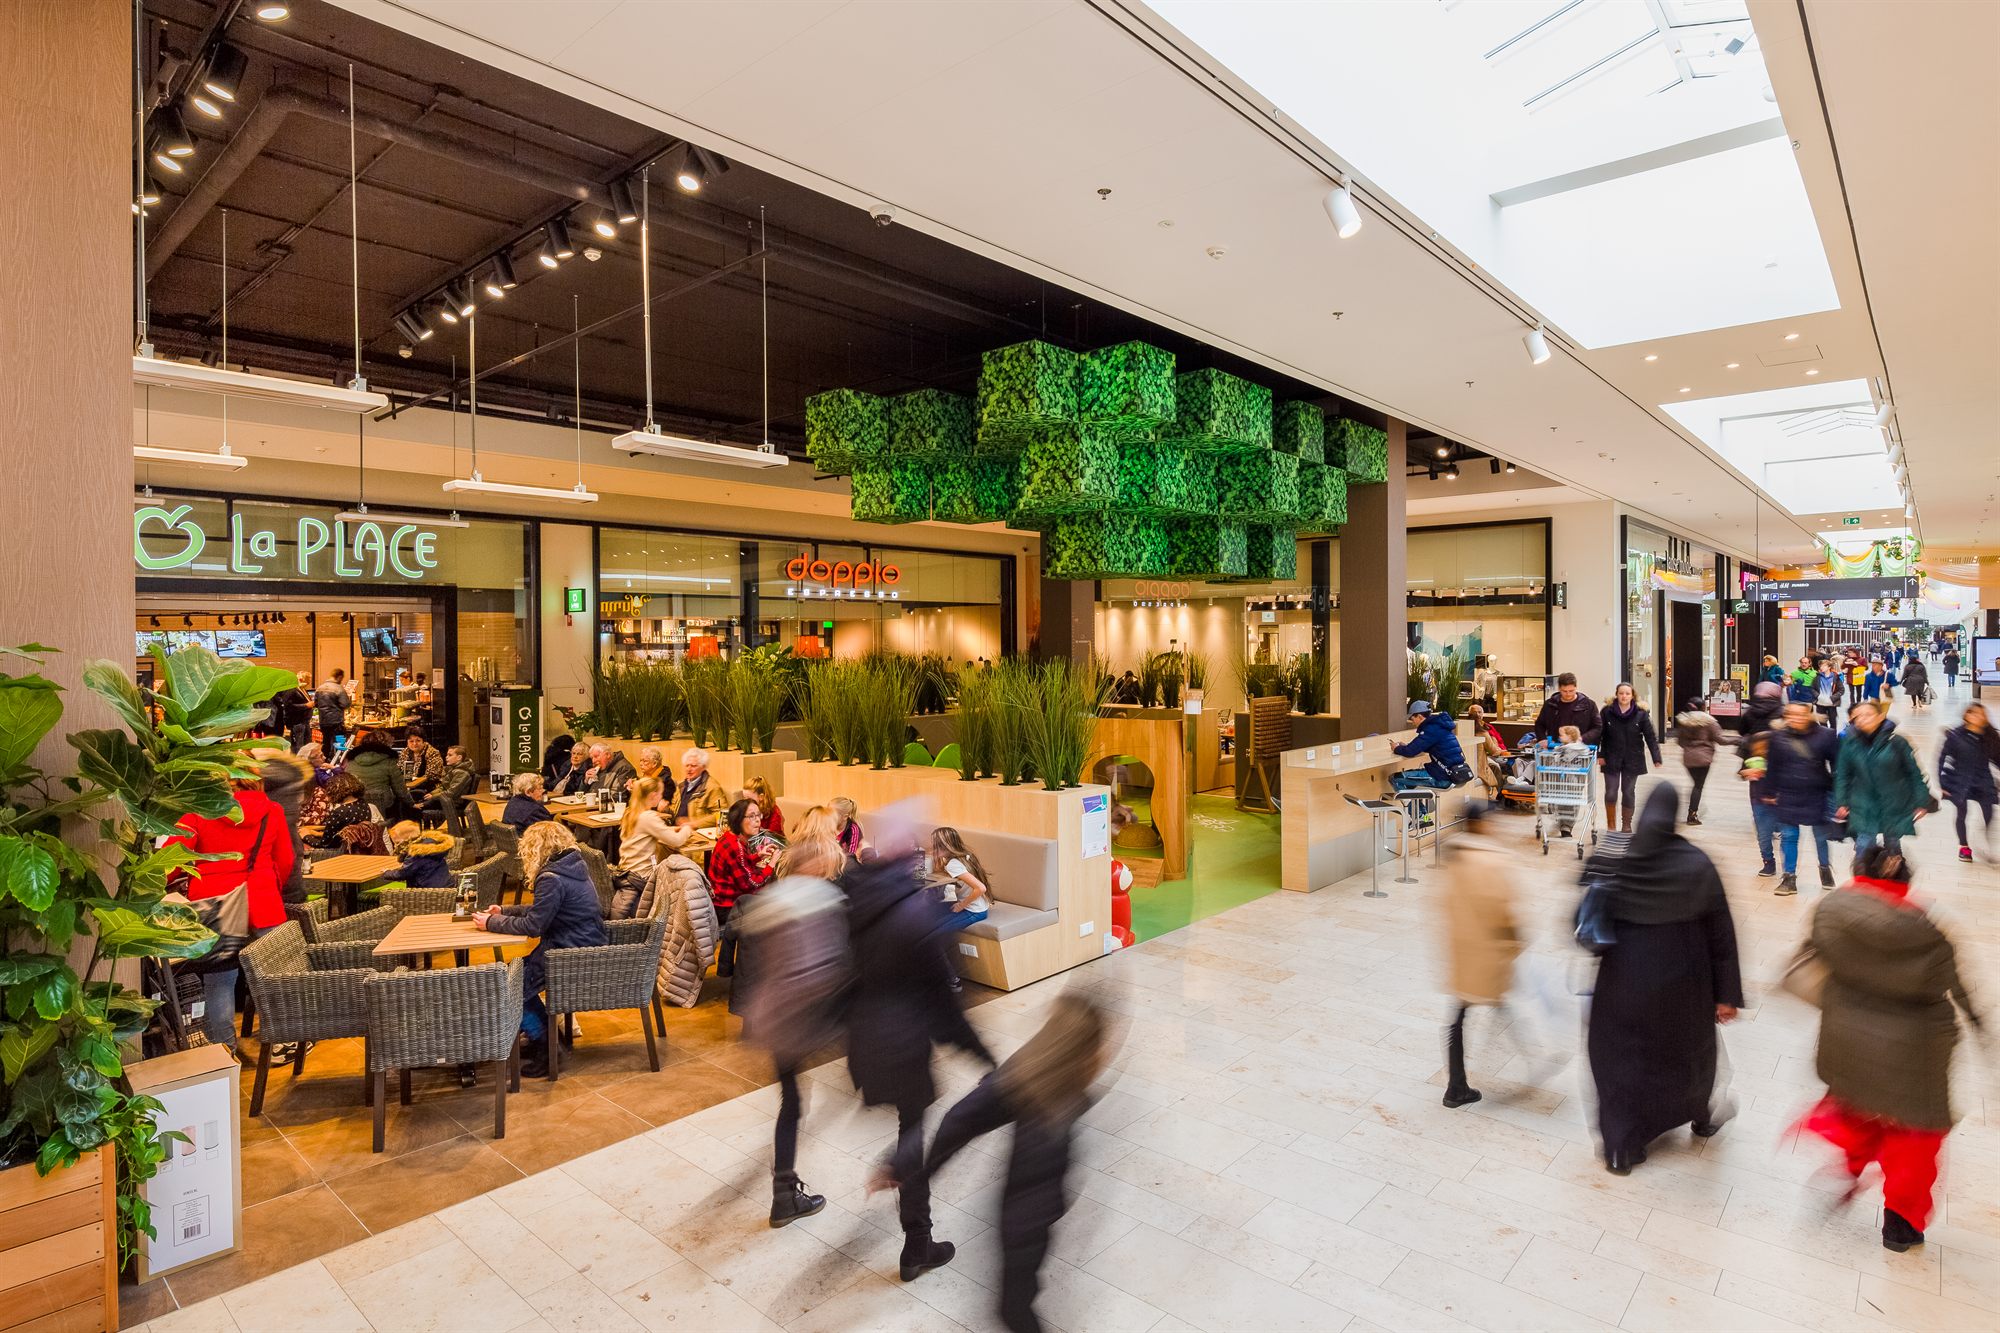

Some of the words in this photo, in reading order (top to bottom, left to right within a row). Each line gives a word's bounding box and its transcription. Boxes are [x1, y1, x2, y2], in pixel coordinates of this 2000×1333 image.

[232, 513, 277, 573] La
[298, 516, 437, 578] PLACE
[785, 552, 900, 588] doppio
[787, 588, 898, 598] ESPRESSO
[518, 723, 531, 733] La
[518, 735, 532, 764] PLACE
